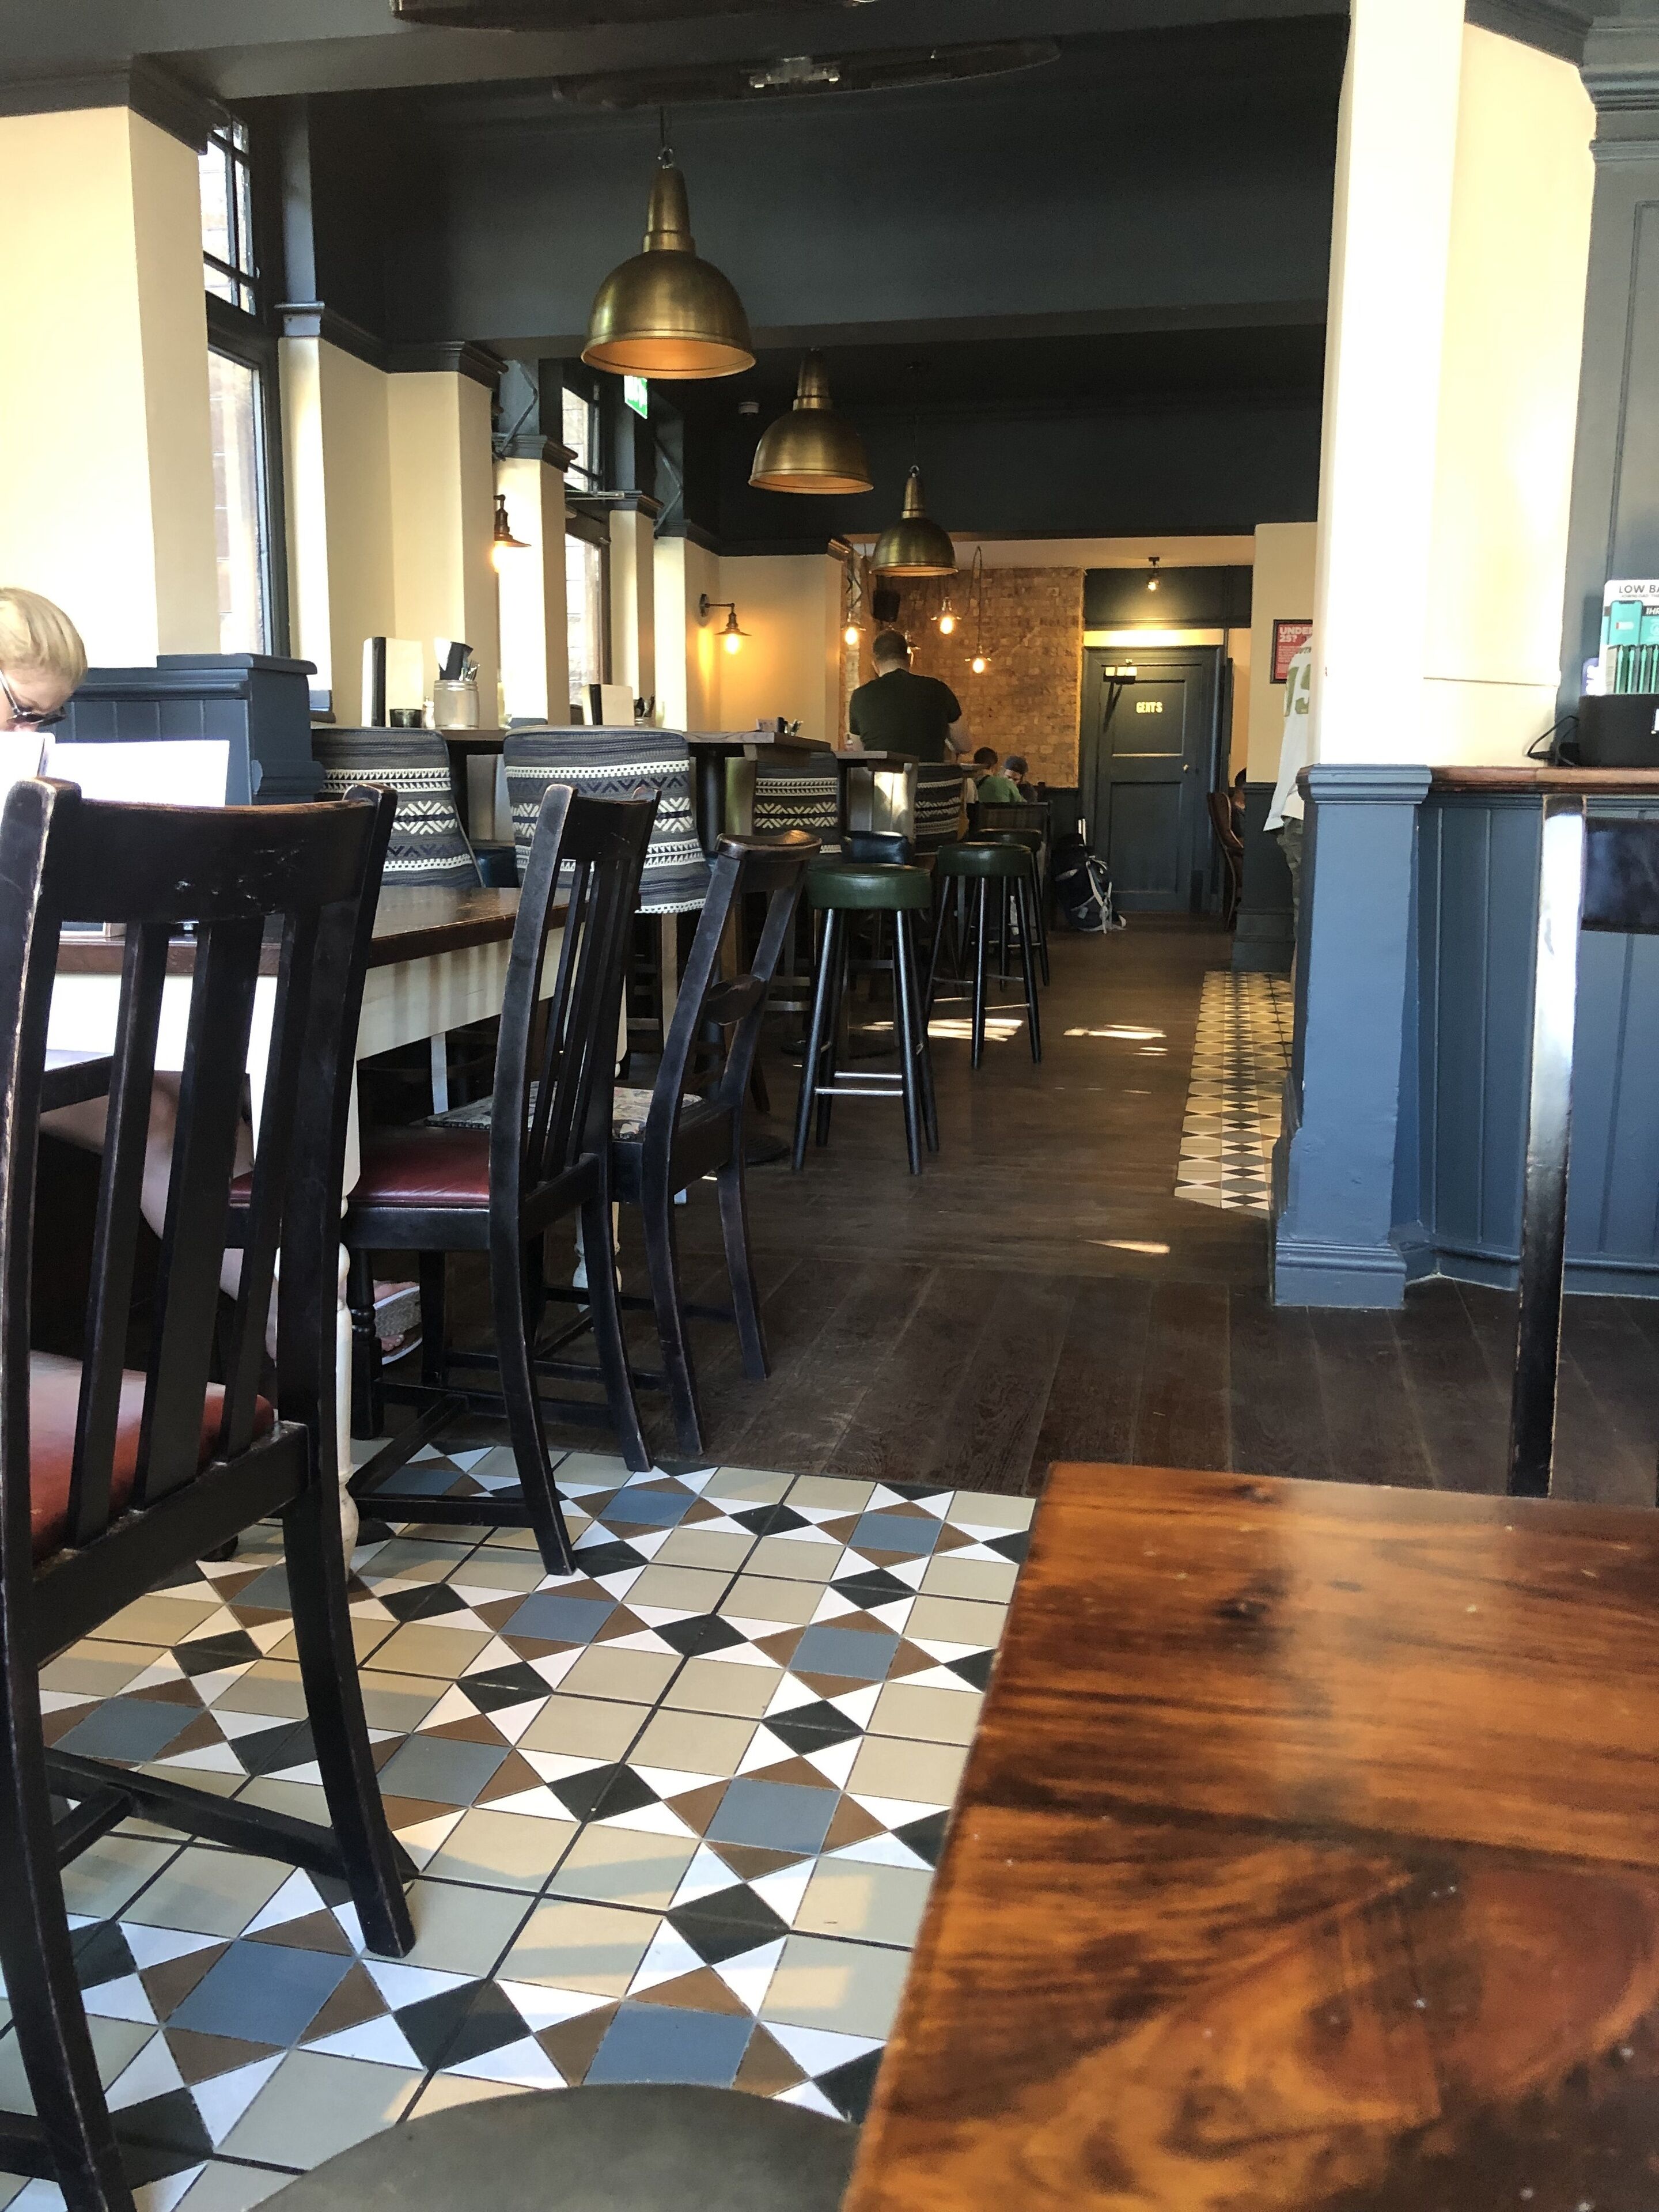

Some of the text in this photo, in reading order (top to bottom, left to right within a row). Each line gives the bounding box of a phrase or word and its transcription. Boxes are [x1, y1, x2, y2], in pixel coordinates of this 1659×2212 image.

[1619, 585, 1645, 593] LOW
[1279, 635, 1297, 643] 25?
[1136, 702, 1163, 714] GENTS
